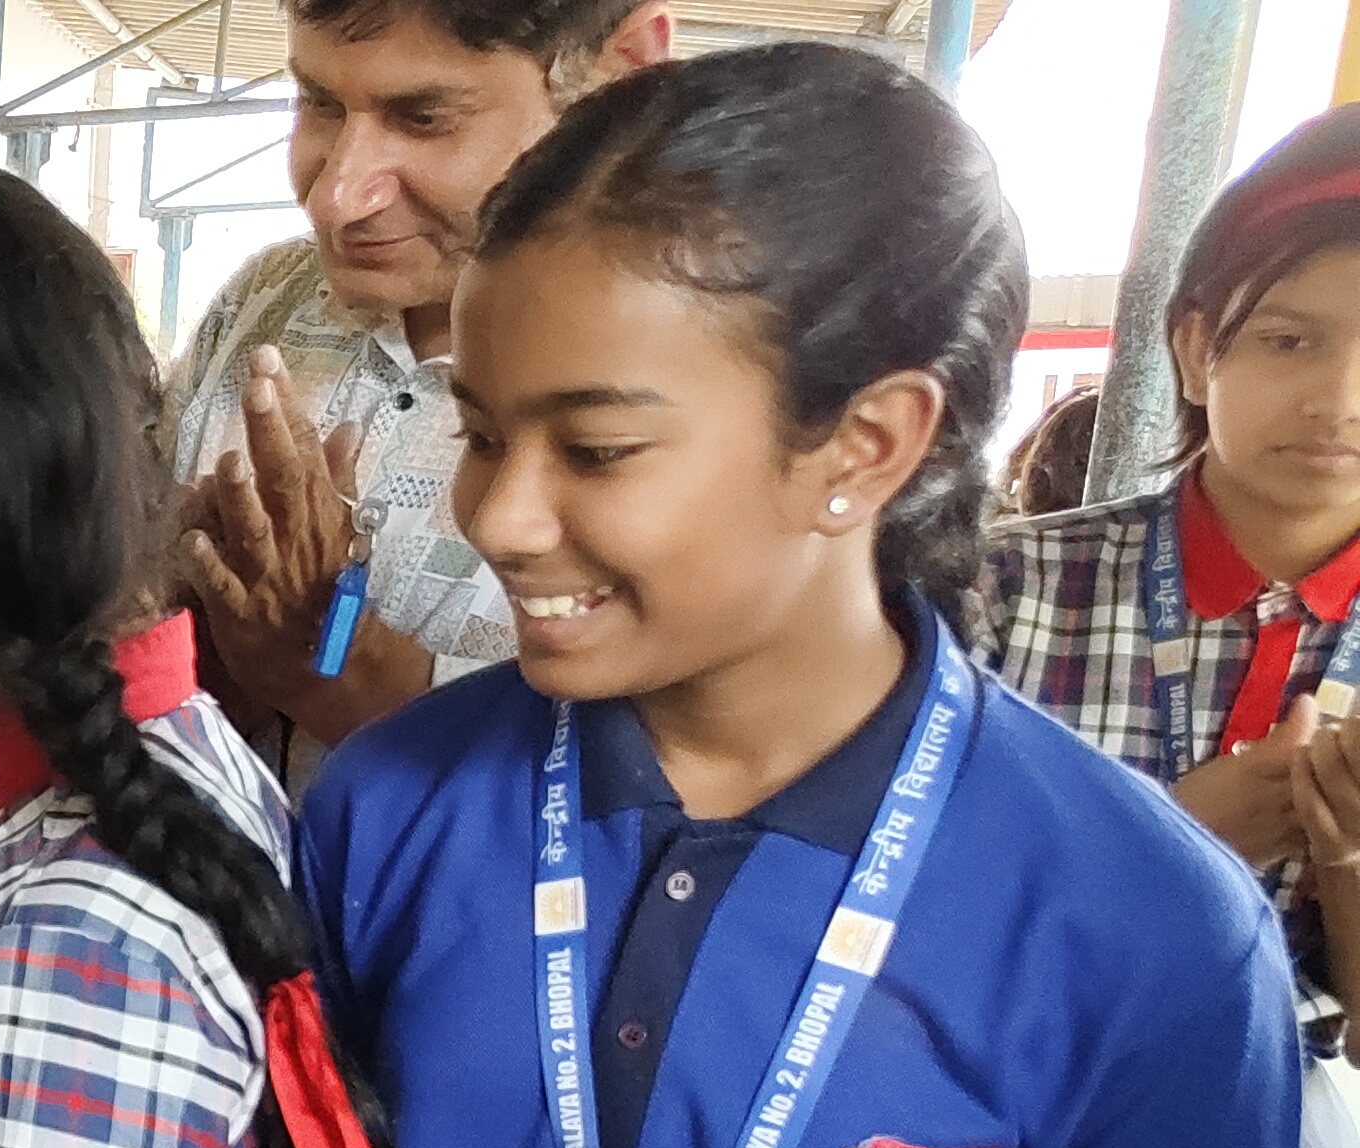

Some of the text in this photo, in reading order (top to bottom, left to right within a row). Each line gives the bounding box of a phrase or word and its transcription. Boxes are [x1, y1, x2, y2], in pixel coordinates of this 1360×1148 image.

[540, 782, 570, 867] केन्द्रीय
[852, 809, 915, 896] केन्द्रीय
[892, 701, 958, 800] विद्यालय
[547, 947, 575, 1031] BHOPAL
[785, 980, 846, 1067] BHOPAL
[775, 1067, 809, 1091] 2,
